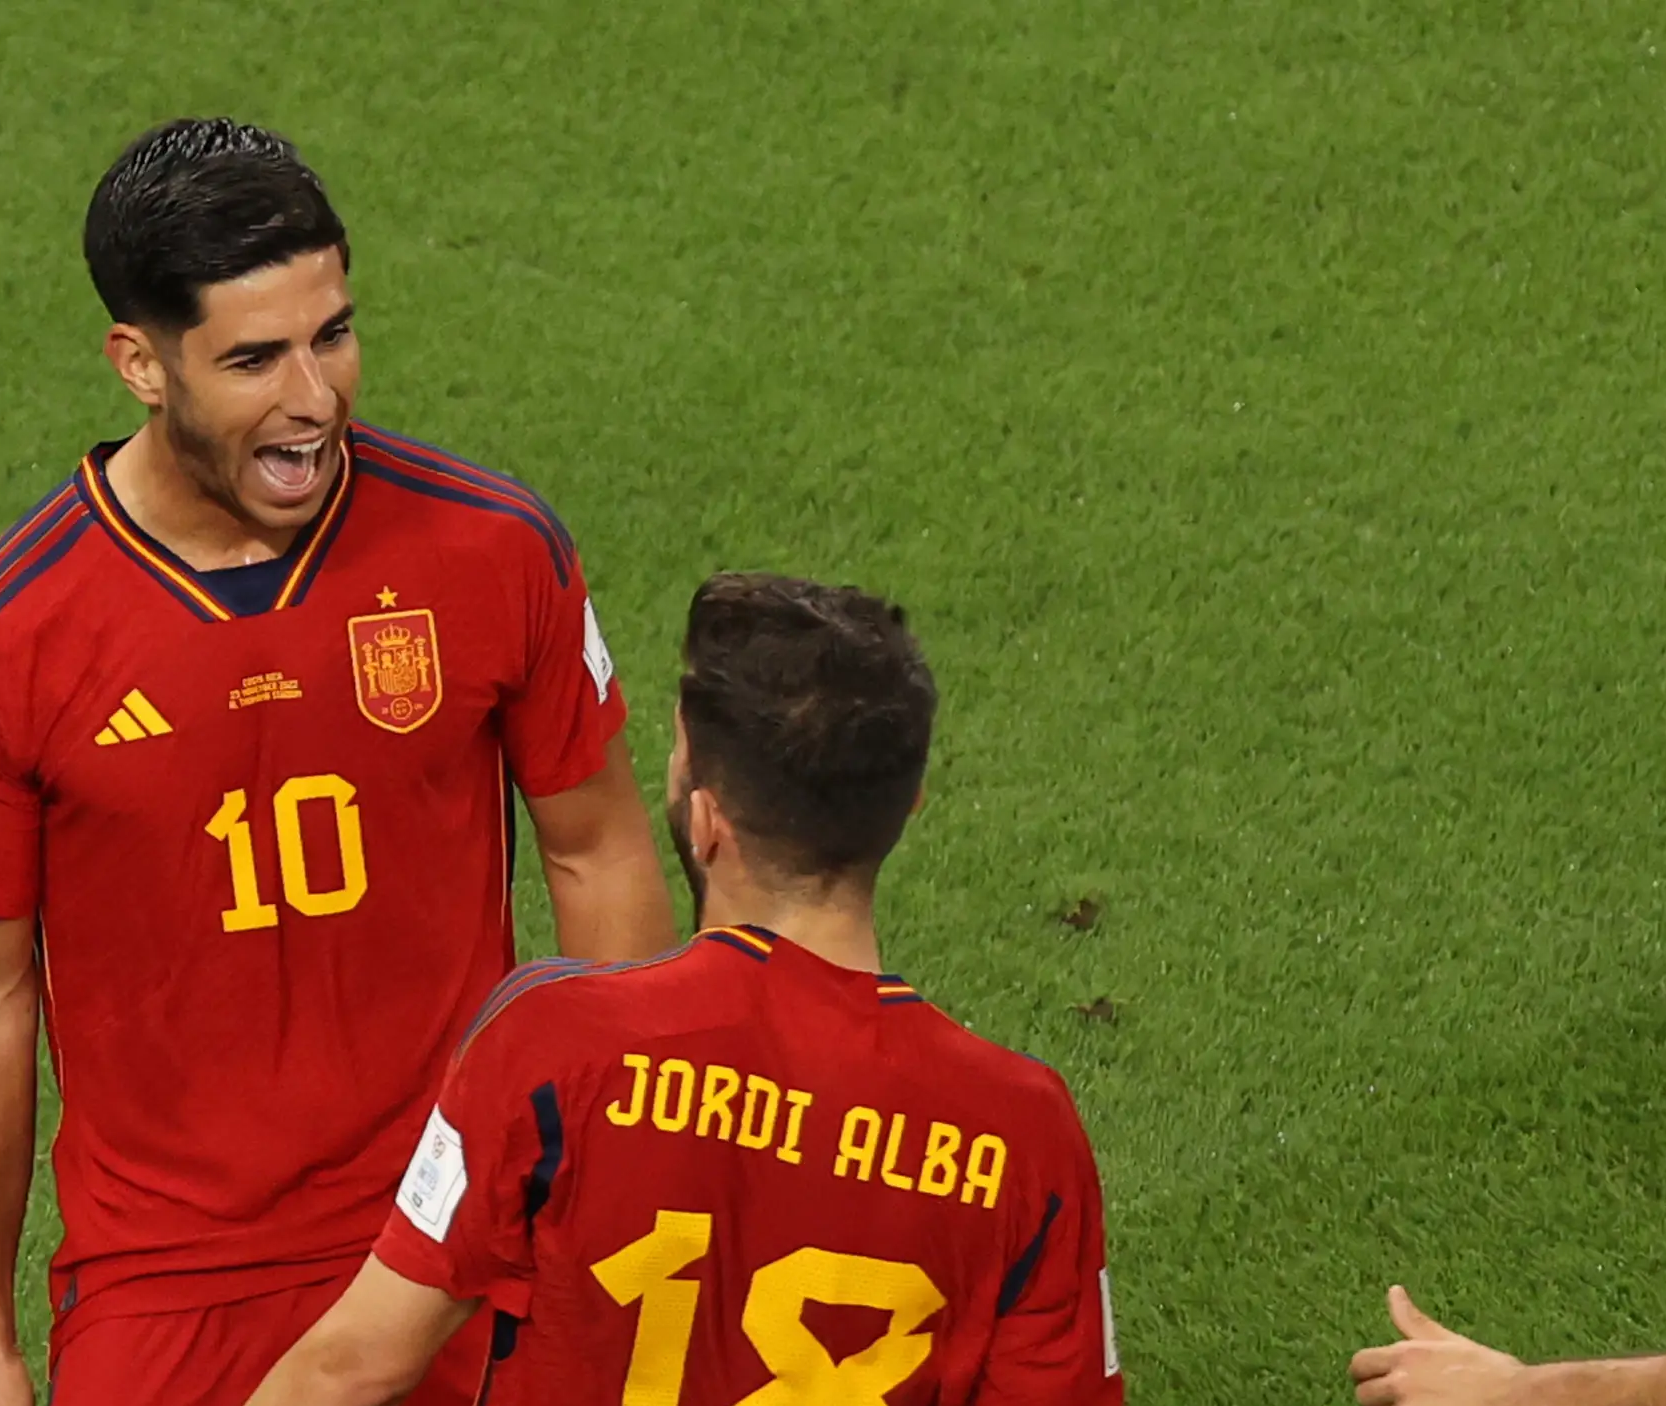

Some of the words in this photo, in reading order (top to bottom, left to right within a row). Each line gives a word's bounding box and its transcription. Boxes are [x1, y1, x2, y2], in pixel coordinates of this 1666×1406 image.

[205, 774, 367, 932] 10
[606, 1054, 813, 1164] JORDI
[834, 1106, 1007, 1208] ALBA
